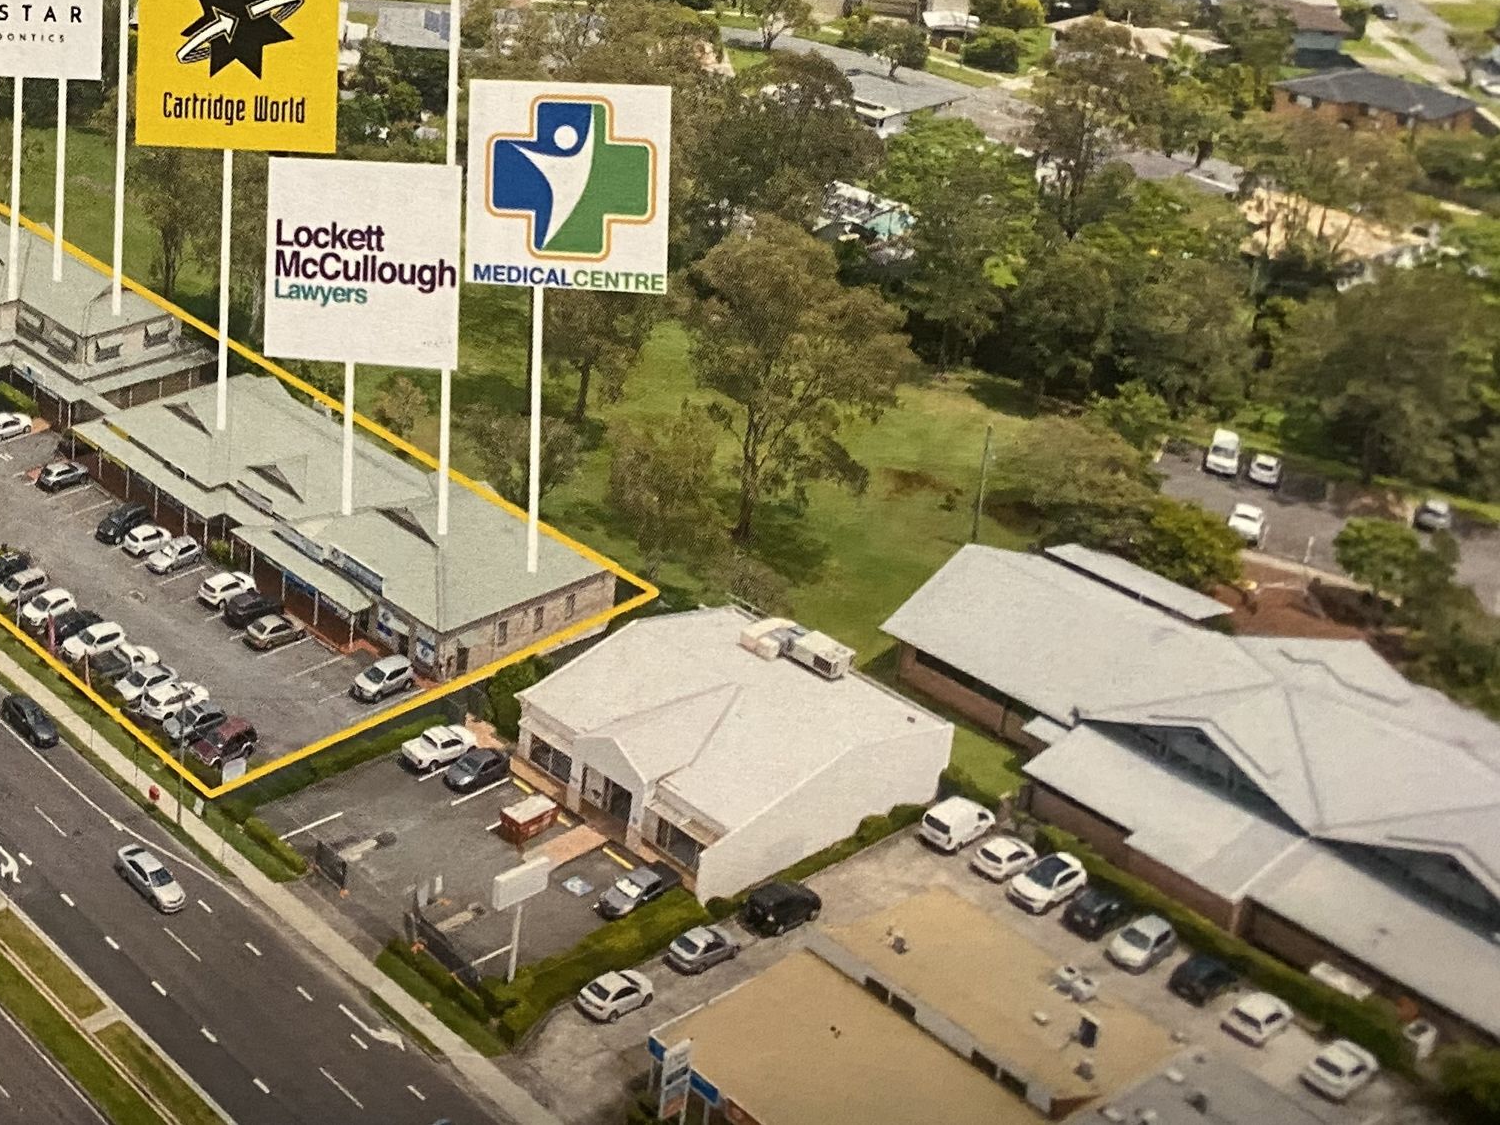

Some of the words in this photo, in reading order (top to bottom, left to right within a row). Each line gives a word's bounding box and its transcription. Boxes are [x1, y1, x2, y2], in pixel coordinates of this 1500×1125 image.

[162, 91, 246, 126] Cartridge
[253, 95, 307, 124] World
[275, 219, 384, 252] Lockett
[275, 250, 456, 294] McCullough
[274, 278, 368, 307] Lawyers
